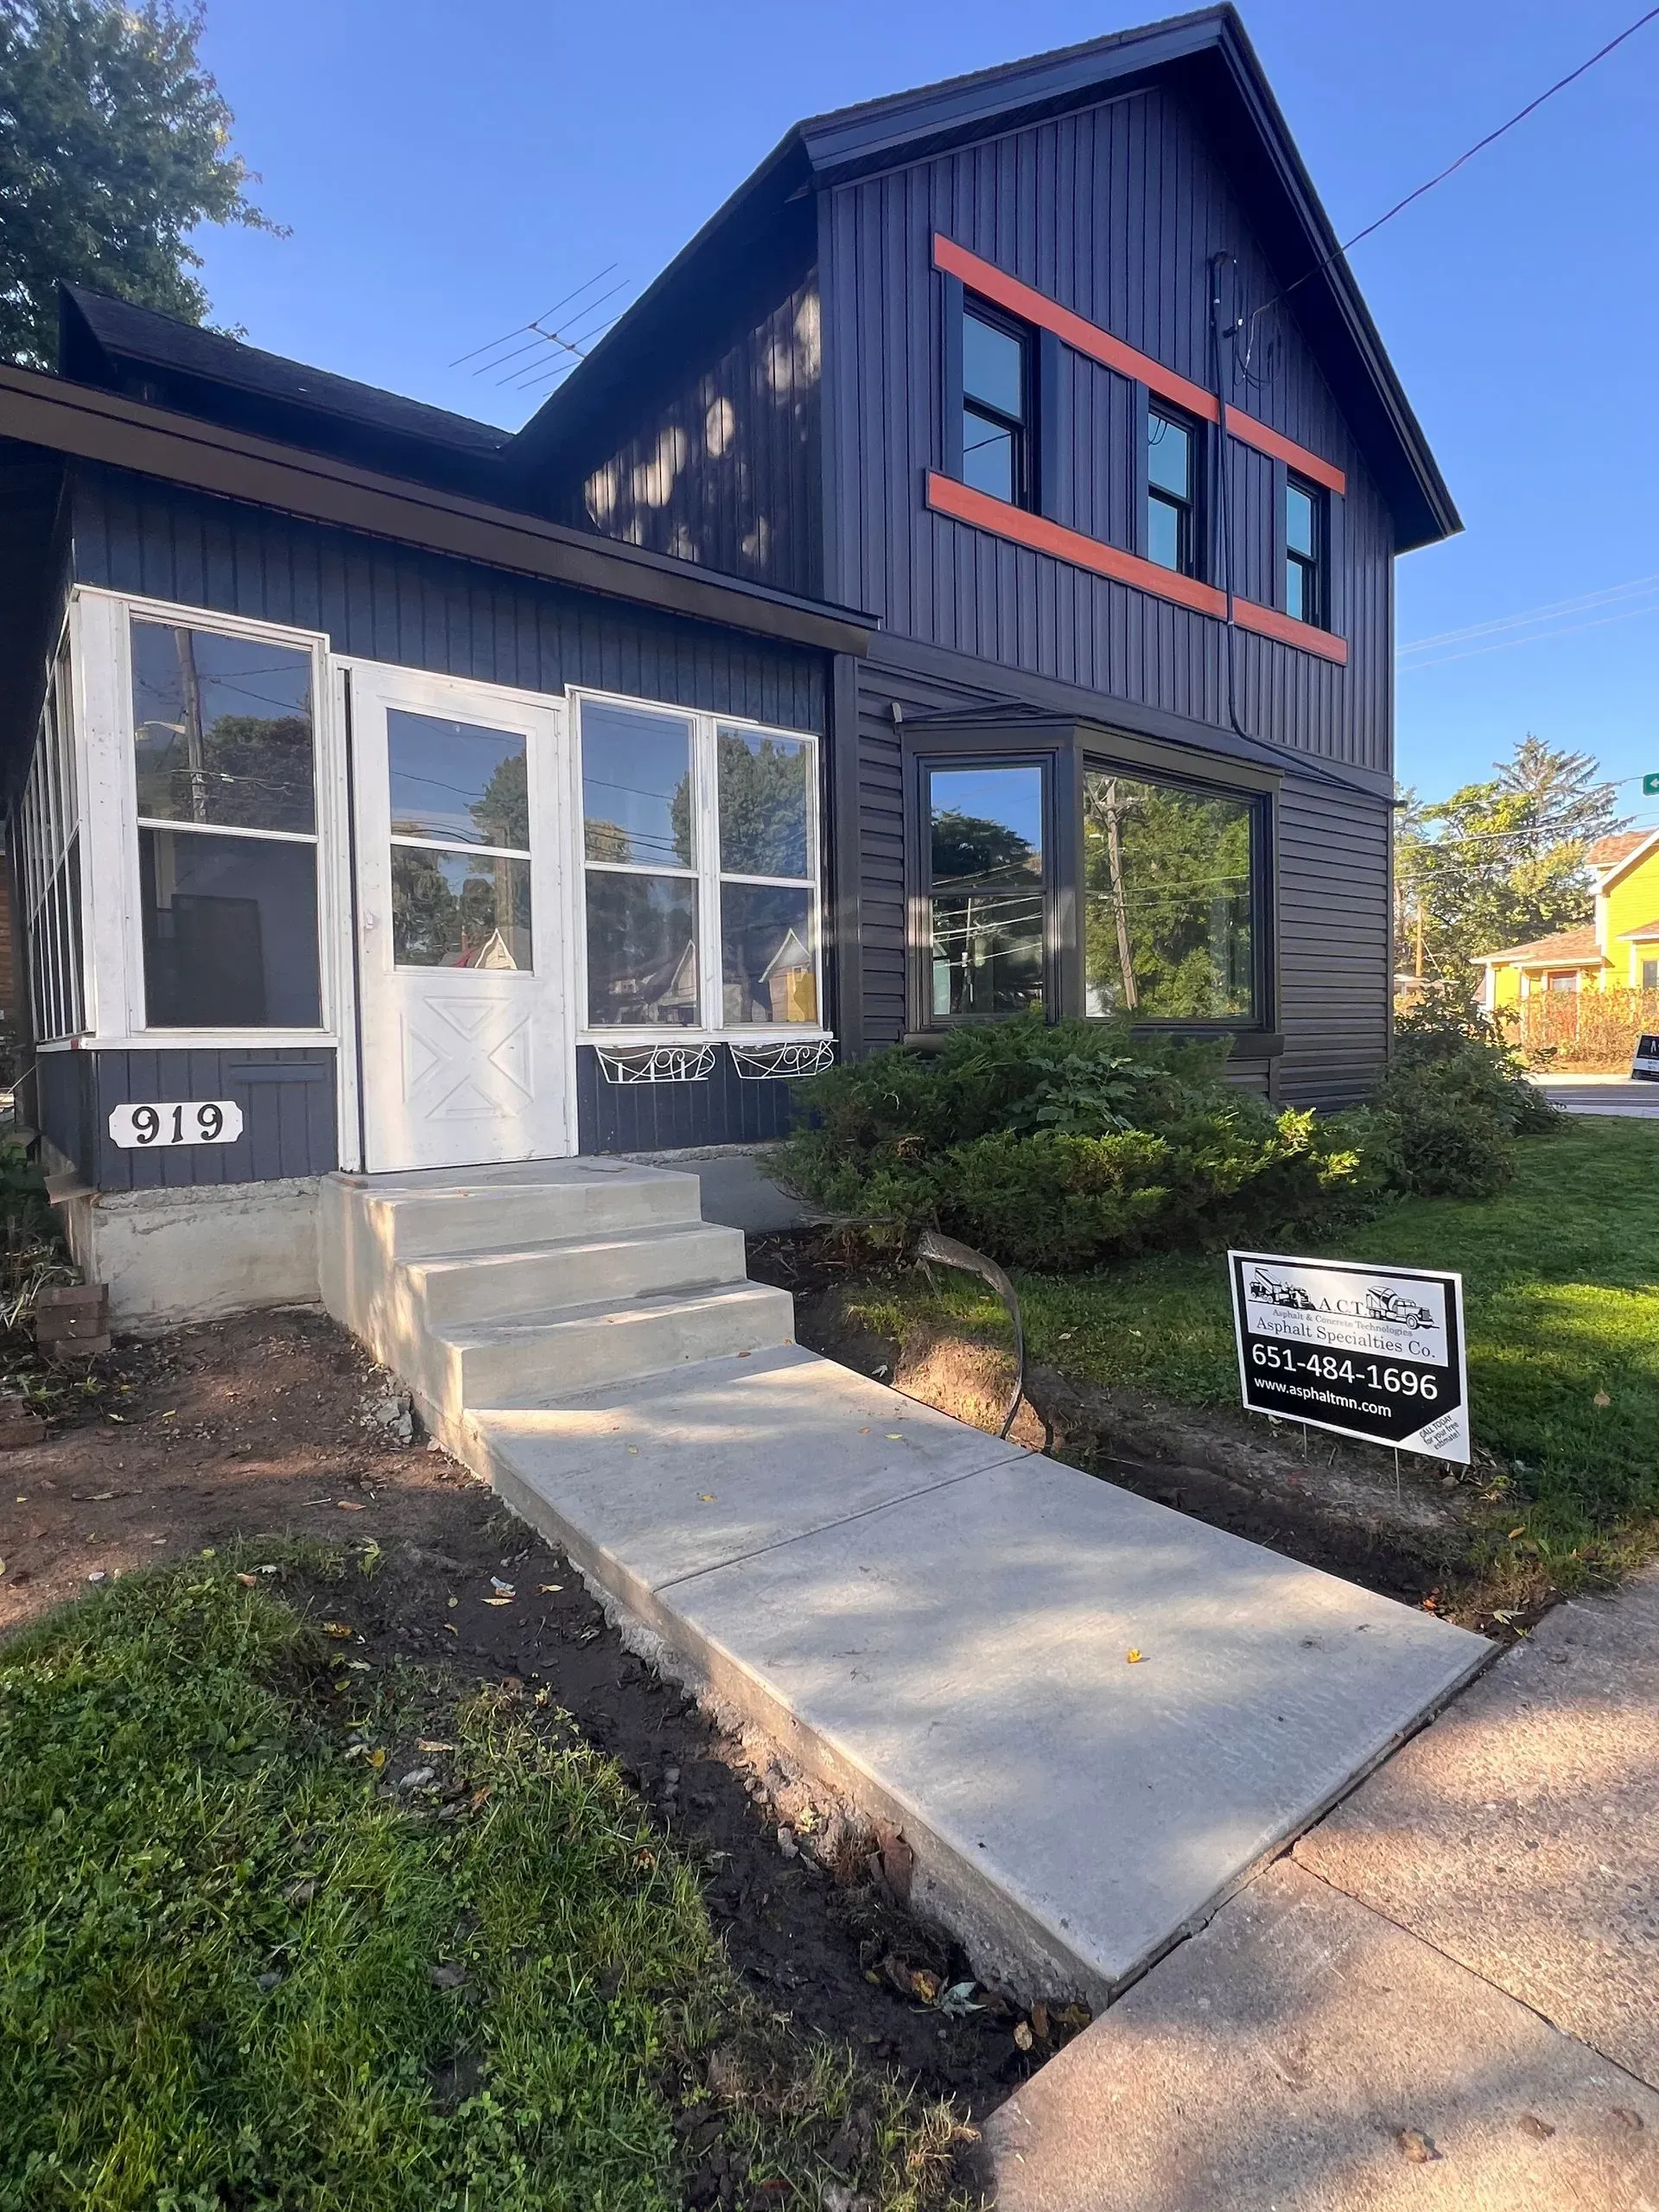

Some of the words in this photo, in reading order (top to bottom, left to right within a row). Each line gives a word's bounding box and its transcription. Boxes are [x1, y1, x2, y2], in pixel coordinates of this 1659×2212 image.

[131, 1103, 223, 1144] 919
[1256, 1317, 1312, 1337] Asphalt
[1317, 1325, 1402, 1352] Specialties
[1408, 1340, 1435, 1357] Co.
[1272, 1309, 1303, 1320] Asphalt
[1315, 1314, 1353, 1328] Concrete
[1355, 1320, 1413, 1337] Technologies
[1252, 1343, 1438, 1400] 651-484-1696
[1254, 1377, 1392, 1417] www.asphaltmn.com
[1419, 1427, 1434, 1438] CALL
[1432, 1414, 1452, 1429] TODAY
[1433, 1429, 1446, 1443] your
[1445, 1421, 1459, 1432] free
